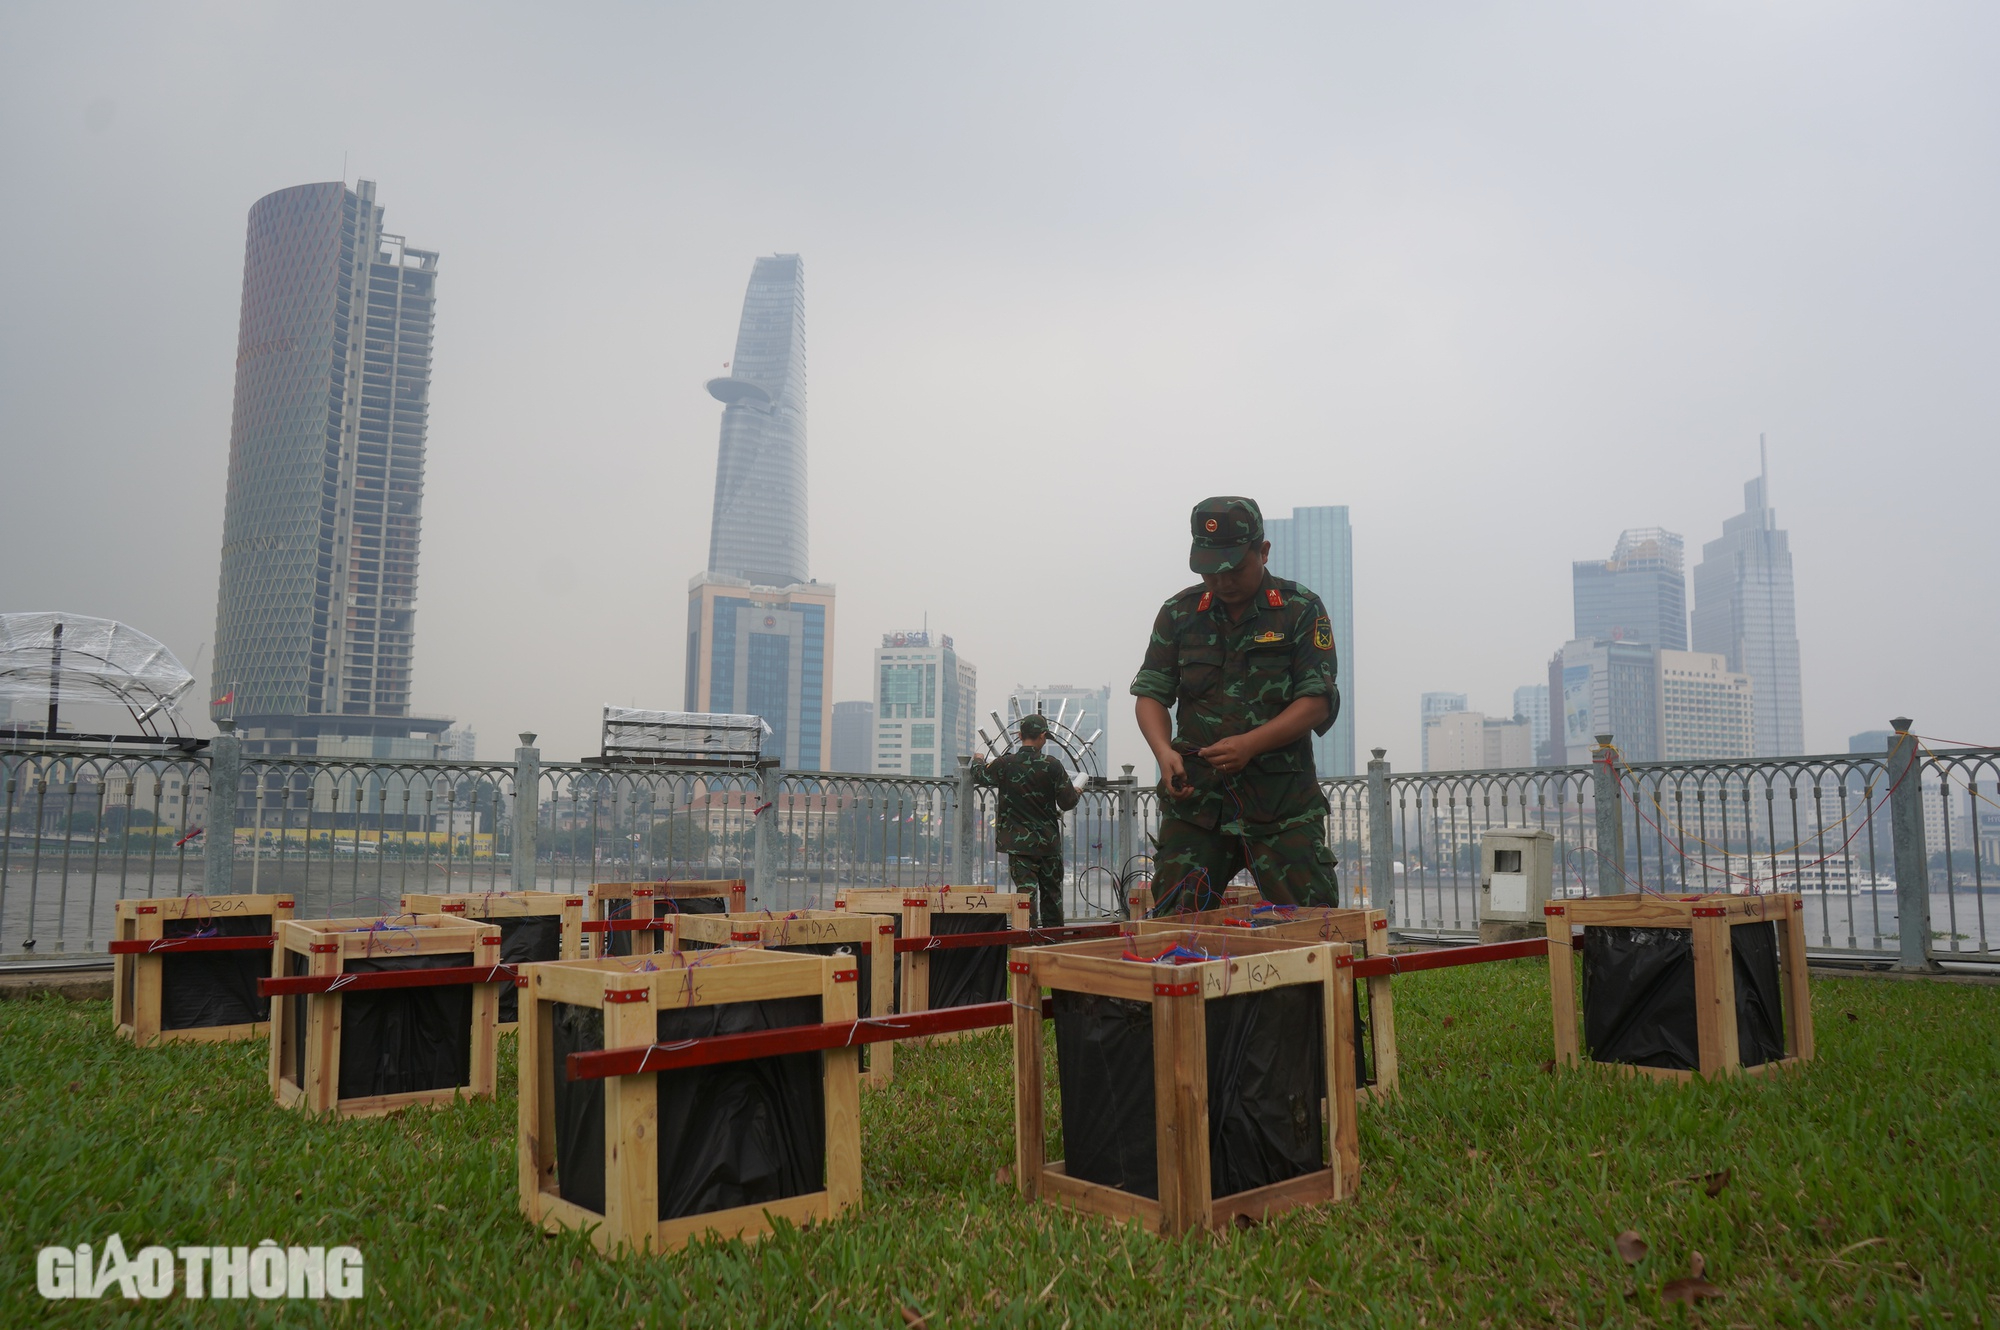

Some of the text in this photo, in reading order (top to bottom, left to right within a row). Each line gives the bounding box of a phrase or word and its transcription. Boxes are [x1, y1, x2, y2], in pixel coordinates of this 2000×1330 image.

[906, 632, 928, 642] SCB
[1711, 657, 1719, 671] R
[210, 900, 249, 913] 20A
[965, 895, 988, 911] 5A
[1247, 961, 1281, 991] 16A
